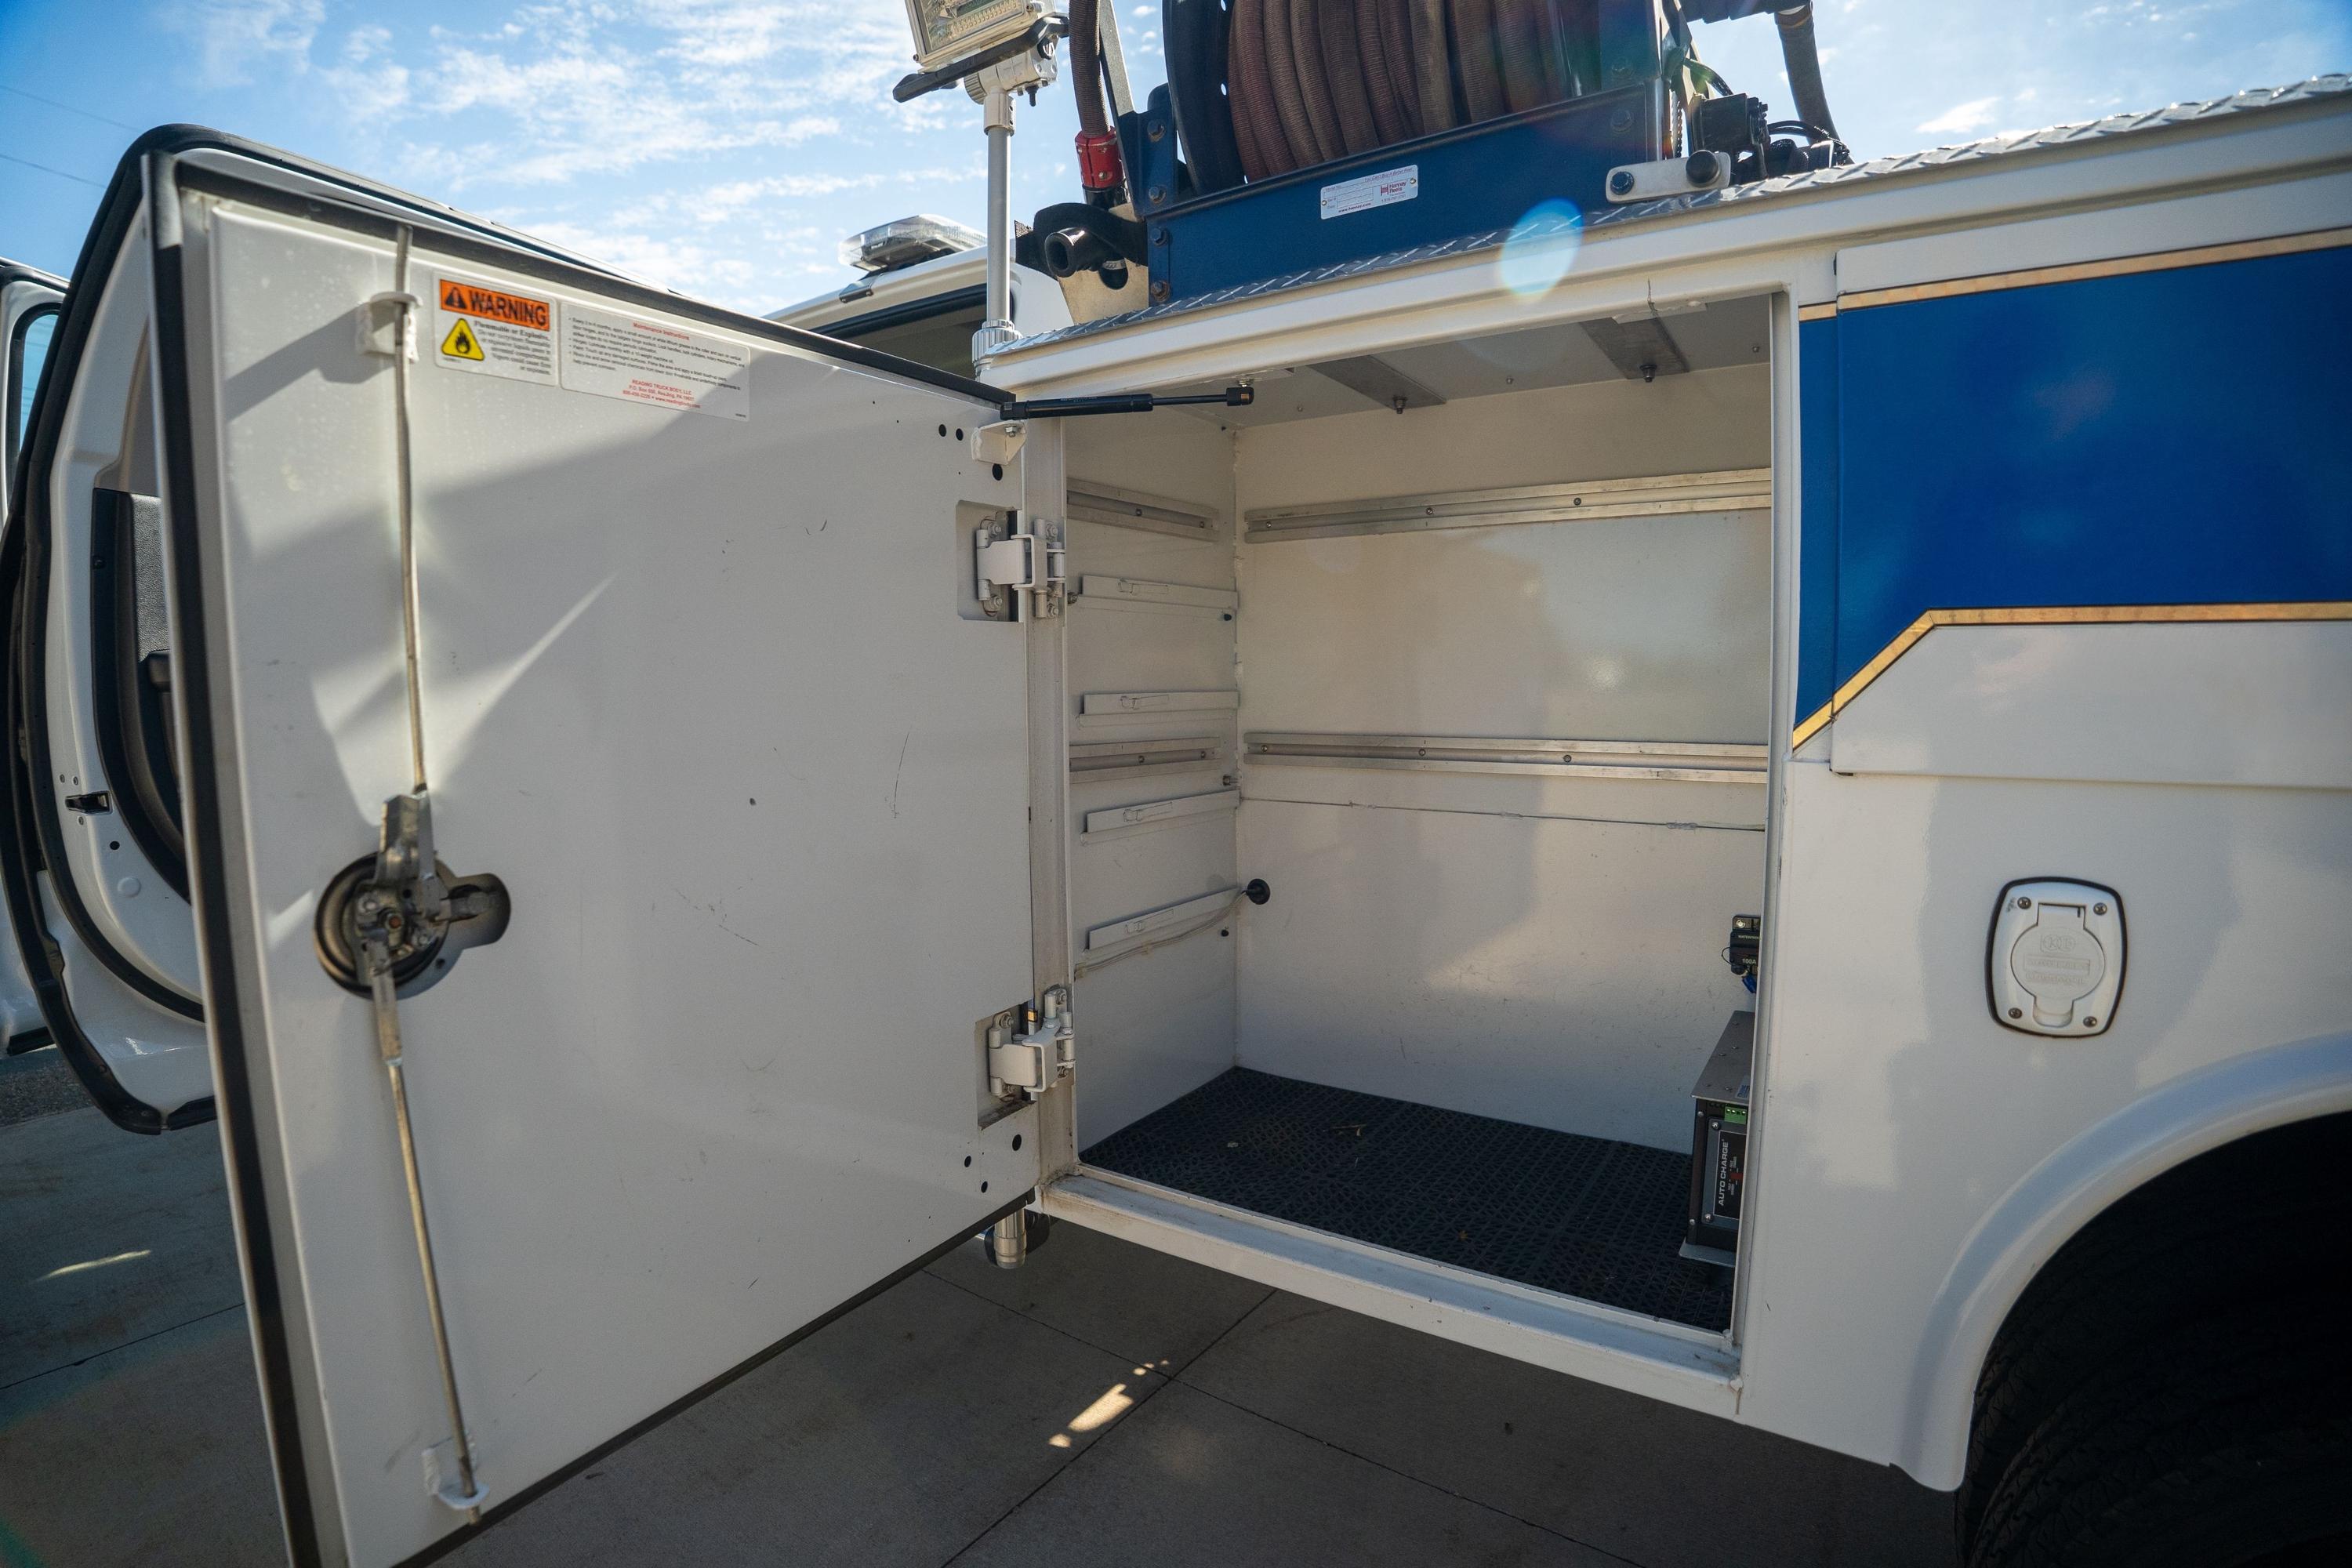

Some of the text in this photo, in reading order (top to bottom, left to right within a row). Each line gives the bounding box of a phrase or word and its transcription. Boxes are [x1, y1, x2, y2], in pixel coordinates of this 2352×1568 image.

[470, 290, 546, 326] WARNING
[633, 323, 689, 340] Maintenance Instructions
[1720, 1142, 1729, 1179] CHARGE
